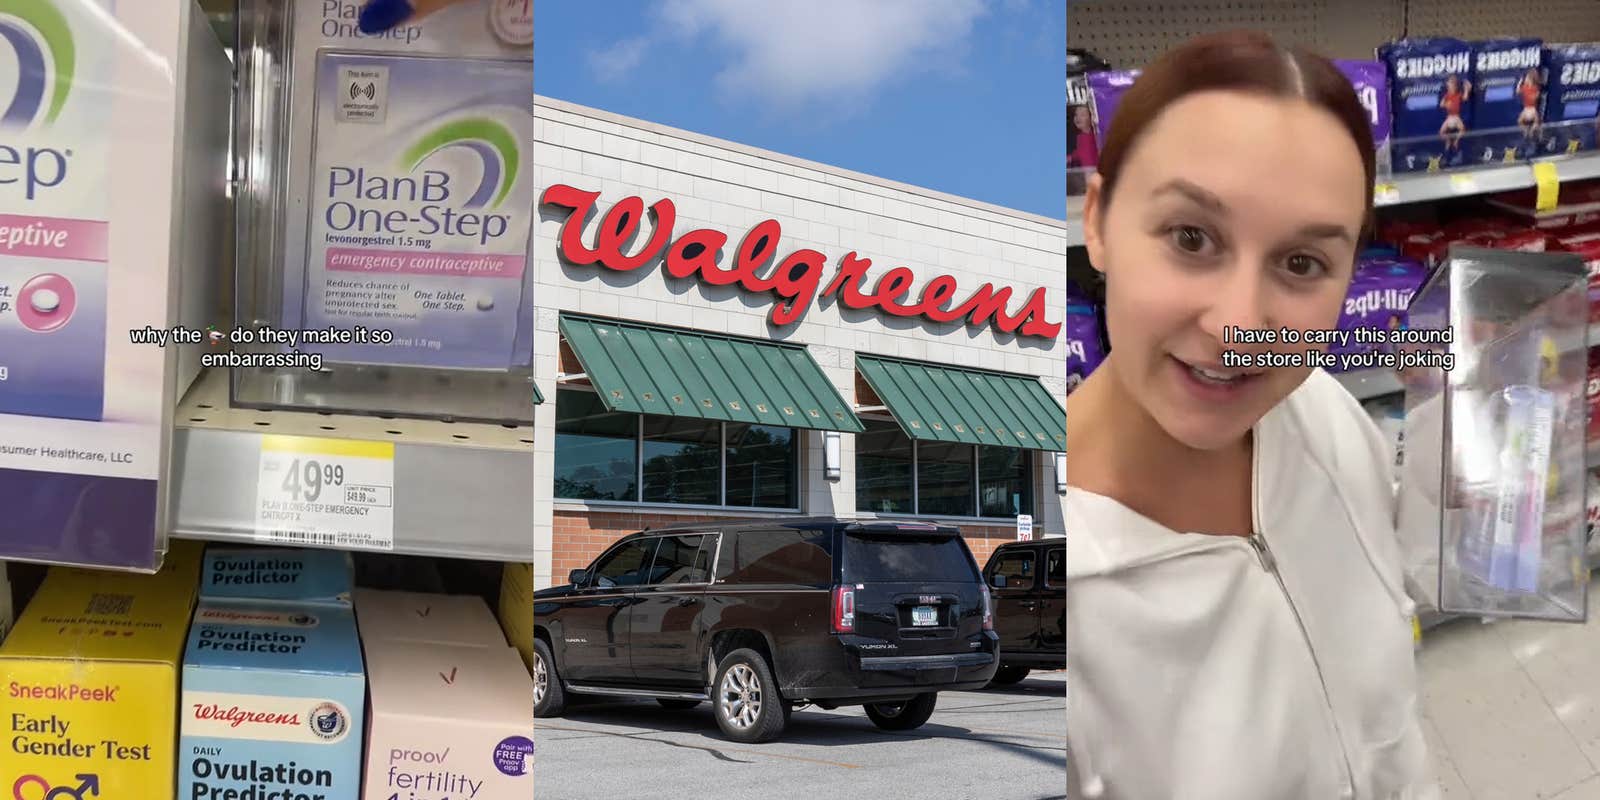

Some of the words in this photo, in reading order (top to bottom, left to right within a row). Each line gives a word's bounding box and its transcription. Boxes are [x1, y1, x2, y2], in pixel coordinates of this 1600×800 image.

[322, 0, 365, 19] Pla
[329, 167, 416, 201] Plan
[422, 170, 450, 202] B
[326, 201, 507, 245] One-Step
[325, 233, 395, 246] levonorgestrel
[399, 236, 413, 246] 1.5
[415, 238, 431, 248] mg
[331, 253, 405, 271] emergency
[409, 256, 504, 272] contraceptive
[543, 184, 1061, 338] Walgreens
[326, 279, 363, 289] Reduces
[366, 281, 397, 290] chance
[325, 289, 371, 301] pregnancy
[414, 290, 432, 300] One
[325, 299, 379, 310] unprotected
[422, 300, 440, 310] One
[444, 300, 465, 312] Step.
[41, 447, 107, 463] Healthcare,
[110, 453, 133, 464] LLC
[282, 459, 322, 502] 49
[323, 463, 344, 486] 99
[325, 504, 370, 516] EMERGENCY
[213, 560, 304, 572] Ovulation
[212, 572, 299, 585] Predictor
[199, 629, 306, 644] Ovulation
[198, 639, 303, 655] Predictor
[10, 682, 116, 702] SneakPeek
[193, 703, 302, 728] Walgreens
[12, 713, 70, 738] Early
[12, 736, 95, 757] Gender
[101, 741, 151, 760] Test
[193, 746, 221, 755] DAILY
[496, 751, 522, 760] FREE
[192, 757, 332, 787] Ovulation
[388, 766, 483, 798] fertility
[191, 782, 325, 800] Predictor
